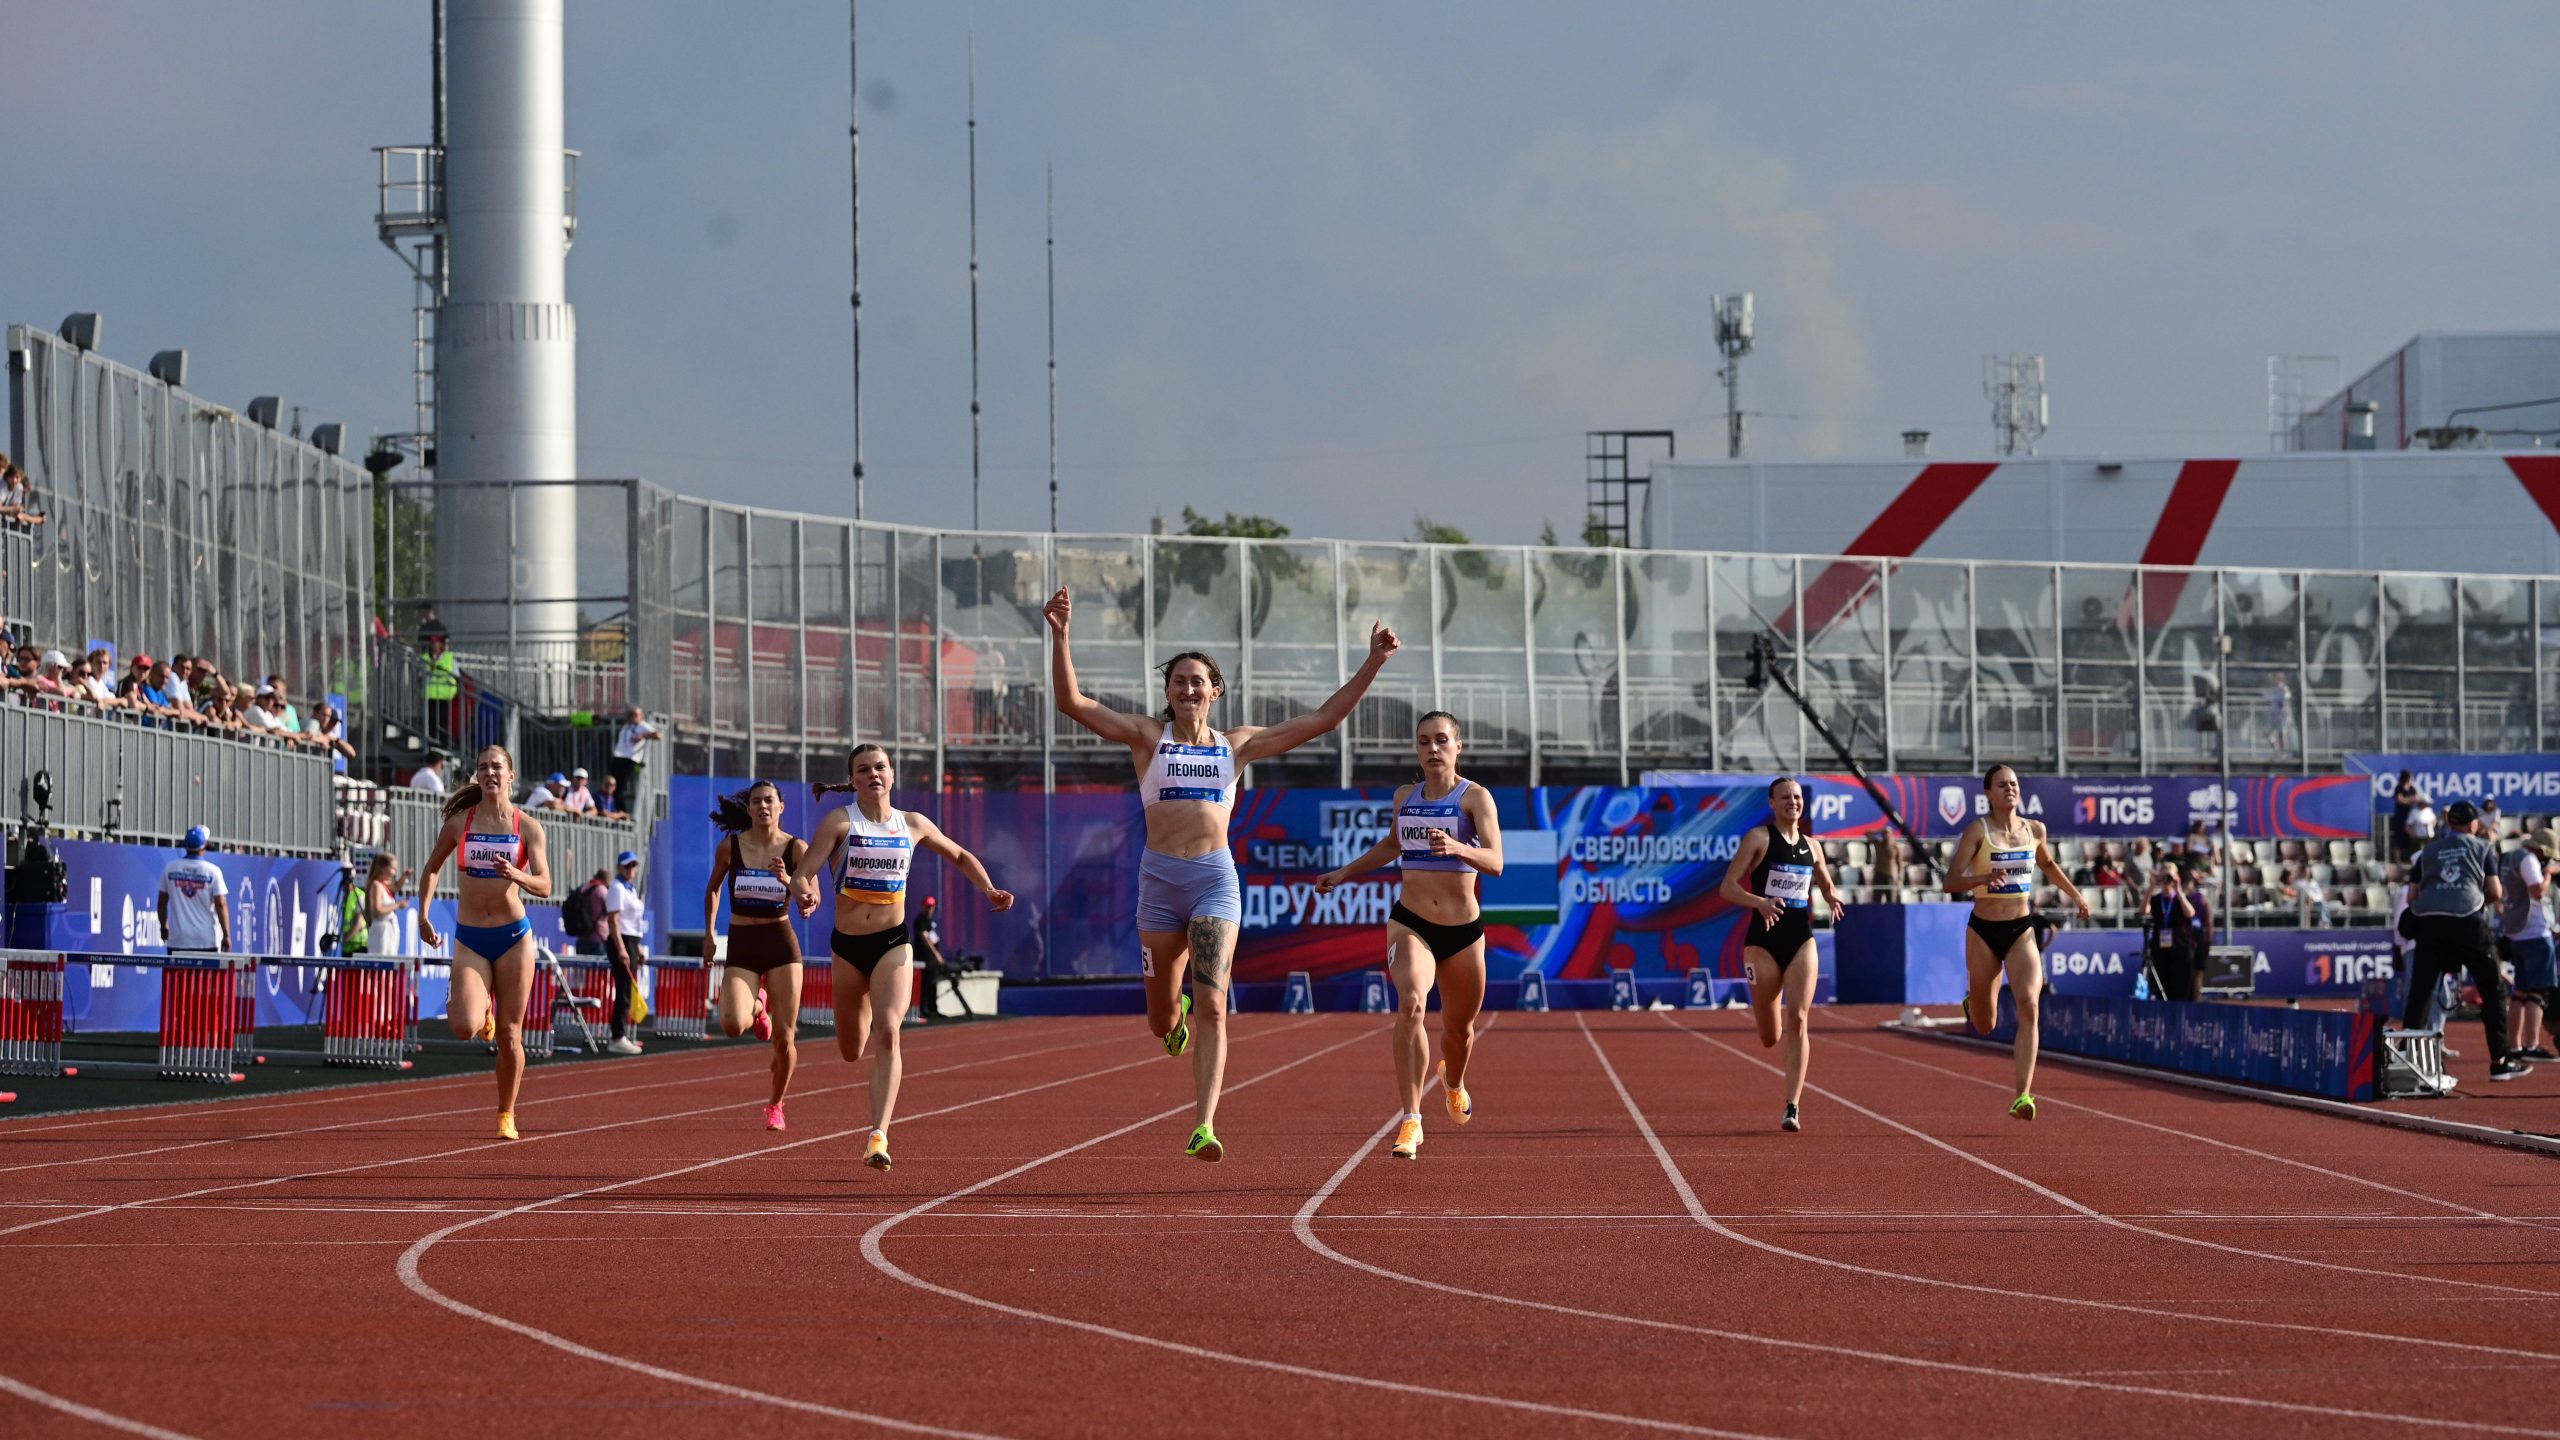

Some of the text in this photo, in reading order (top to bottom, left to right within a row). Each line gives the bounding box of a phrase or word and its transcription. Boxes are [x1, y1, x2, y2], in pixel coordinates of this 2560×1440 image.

[1167, 763, 1220, 778] ЛЕОНОВА
[2100, 797, 2155, 825] ПСБ
[1571, 835, 1741, 866] СВЕРДЛОВСКАЯ
[850, 856, 898, 870] МОРОЗОВА
[1572, 877, 1672, 903] ОБЛАСТЬ
[1747, 966, 1754, 981] 3
[2051, 951, 2124, 975] ВФЛА
[2335, 954, 2394, 984] ПСБ
[1291, 984, 1305, 1006] 7
[1367, 983, 1381, 1006] 6
[1524, 982, 1539, 1002] 4
[1615, 982, 1629, 1003] 3
[1692, 981, 1706, 1003] 2
